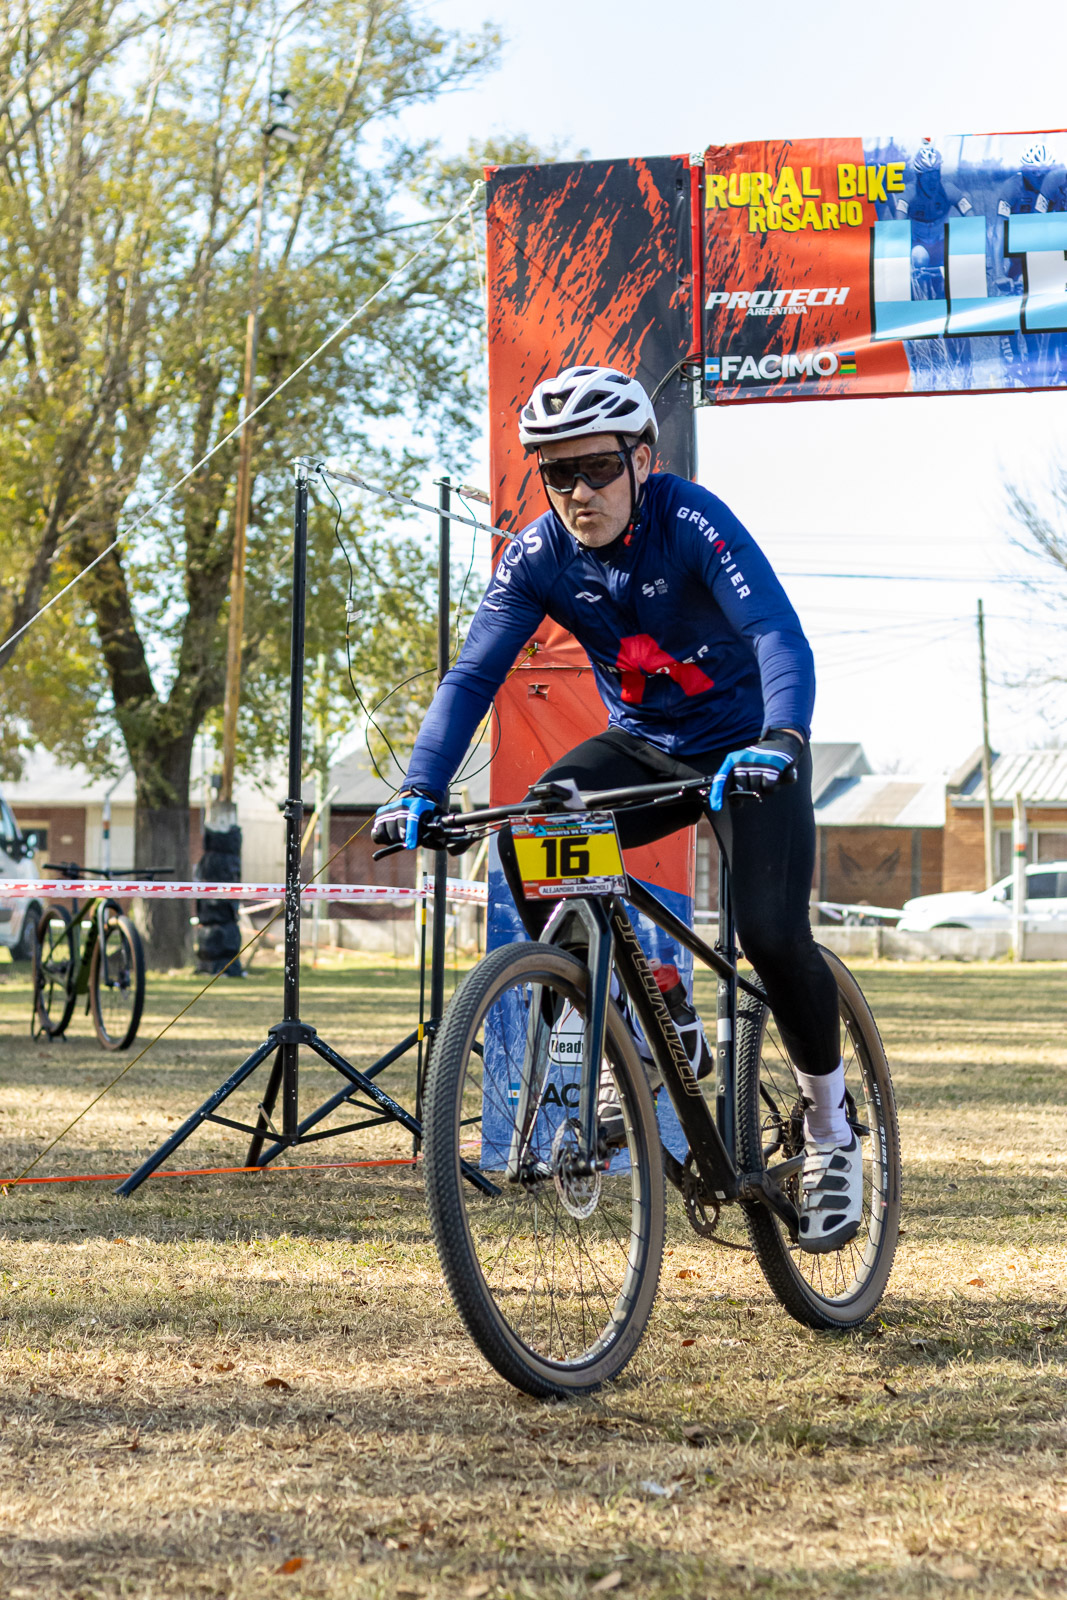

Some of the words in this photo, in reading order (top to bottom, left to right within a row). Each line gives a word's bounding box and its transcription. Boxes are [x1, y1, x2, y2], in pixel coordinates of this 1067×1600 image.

[705, 166, 822, 210] RURAL
[838, 162, 906, 202] BIKE
[748, 200, 864, 232] ROSARIO
[705, 287, 850, 309] PROTECH
[745, 305, 808, 316] ARGENTINA
[721, 351, 839, 381] FACIMO
[676, 506, 751, 600] GRENADIER
[482, 526, 543, 612] INEOS
[654, 578, 665, 586] UCI
[541, 836, 590, 878] 16
[542, 886, 575, 894] ALEJANDRO
[576, 884, 609, 893] ROMAGNOLI
[551, 1040, 583, 1055] Read
